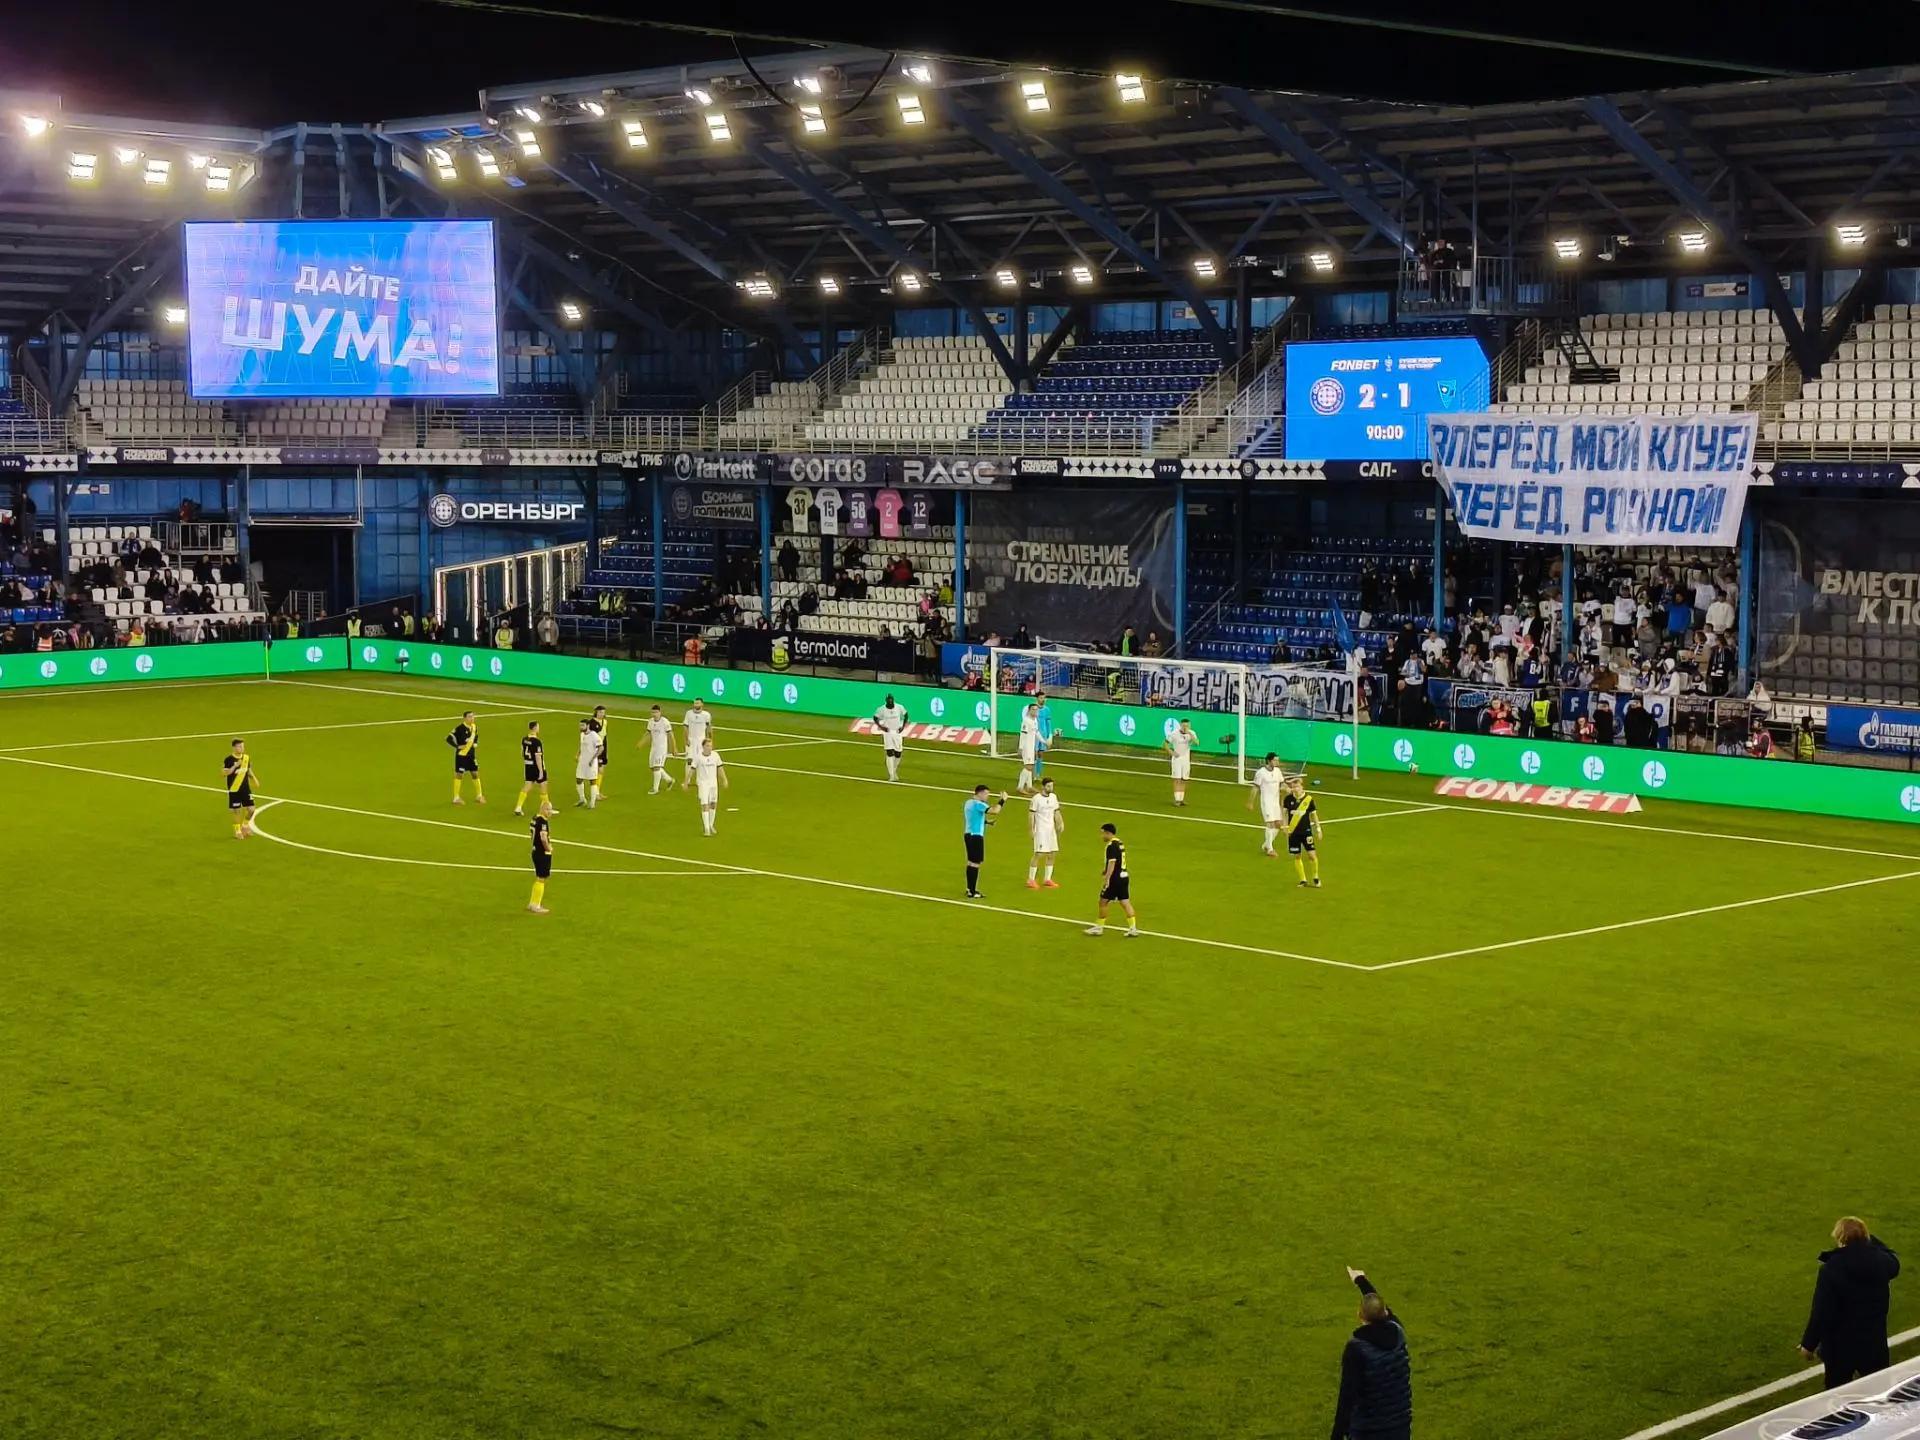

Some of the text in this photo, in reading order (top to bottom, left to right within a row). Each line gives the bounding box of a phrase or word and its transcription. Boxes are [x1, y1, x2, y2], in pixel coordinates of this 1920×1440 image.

[295, 265, 400, 301] ДАЙТЕ
[222, 296, 463, 374] ШУМА!
[1330, 359, 1379, 371] FONBET
[1358, 384, 1375, 409] 2
[1398, 382, 1409, 408] 1
[1366, 425, 1404, 440] 90:00
[1570, 421, 1641, 472] МОЙ
[1648, 425, 1750, 472] КЛУБ!
[693, 457, 756, 480] Tarkett
[1159, 465, 1177, 473] 1976
[461, 503, 584, 520] ОРЕНБУРГ
[794, 498, 805, 515] 33
[823, 500, 834, 517] 15
[852, 501, 866, 519] 58
[885, 502, 892, 517] 2
[914, 502, 926, 517] 12
[1007, 540, 1129, 565] СТРЕМЛЕНИЕ
[1014, 562, 1143, 589] ПОБЕЖДАТЬ!
[1821, 569, 1920, 598] ВМЕСТ
[1857, 598, 1882, 624] К
[794, 637, 867, 659] termoland
[1437, 777, 1630, 812] FON.BET
